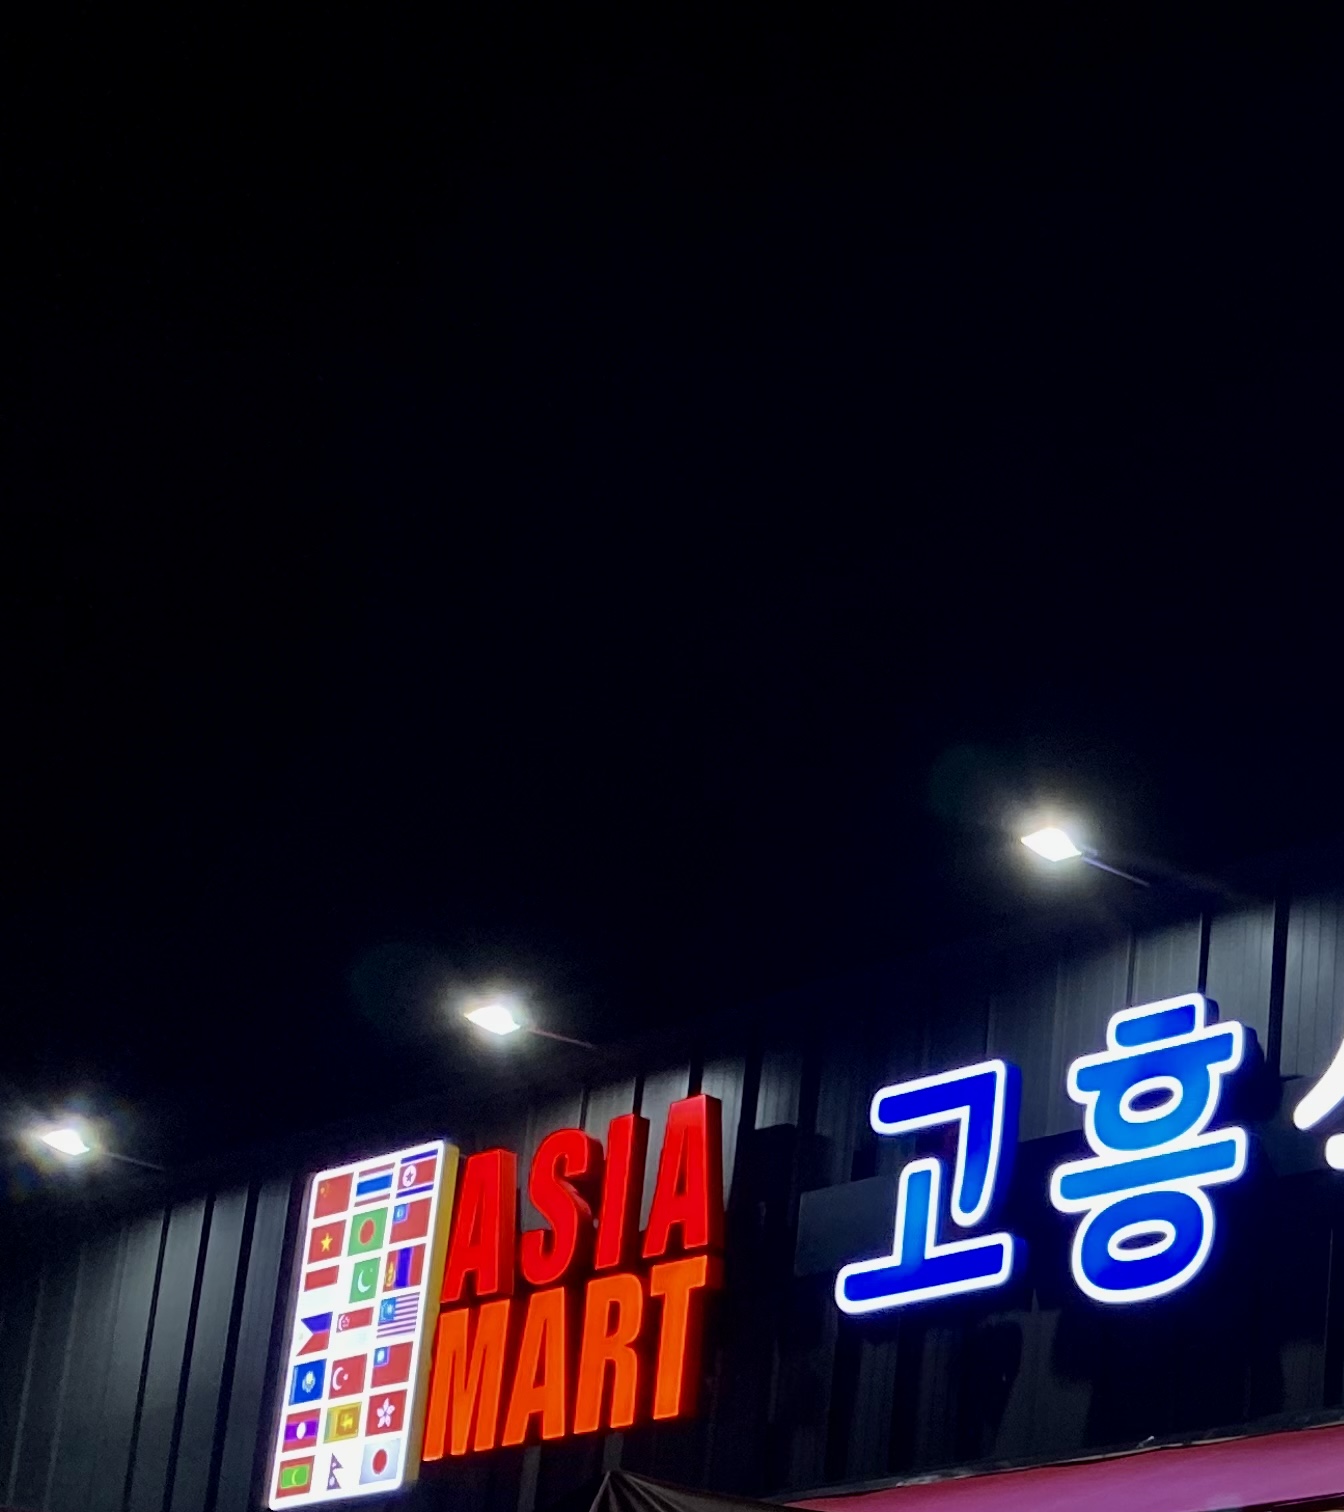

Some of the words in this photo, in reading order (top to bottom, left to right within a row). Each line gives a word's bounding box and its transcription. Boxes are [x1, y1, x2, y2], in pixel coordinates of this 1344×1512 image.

[443, 1094, 722, 1301] ASIA
[834, 992, 1252, 1315] 고흥
[423, 1256, 709, 1461] MART
